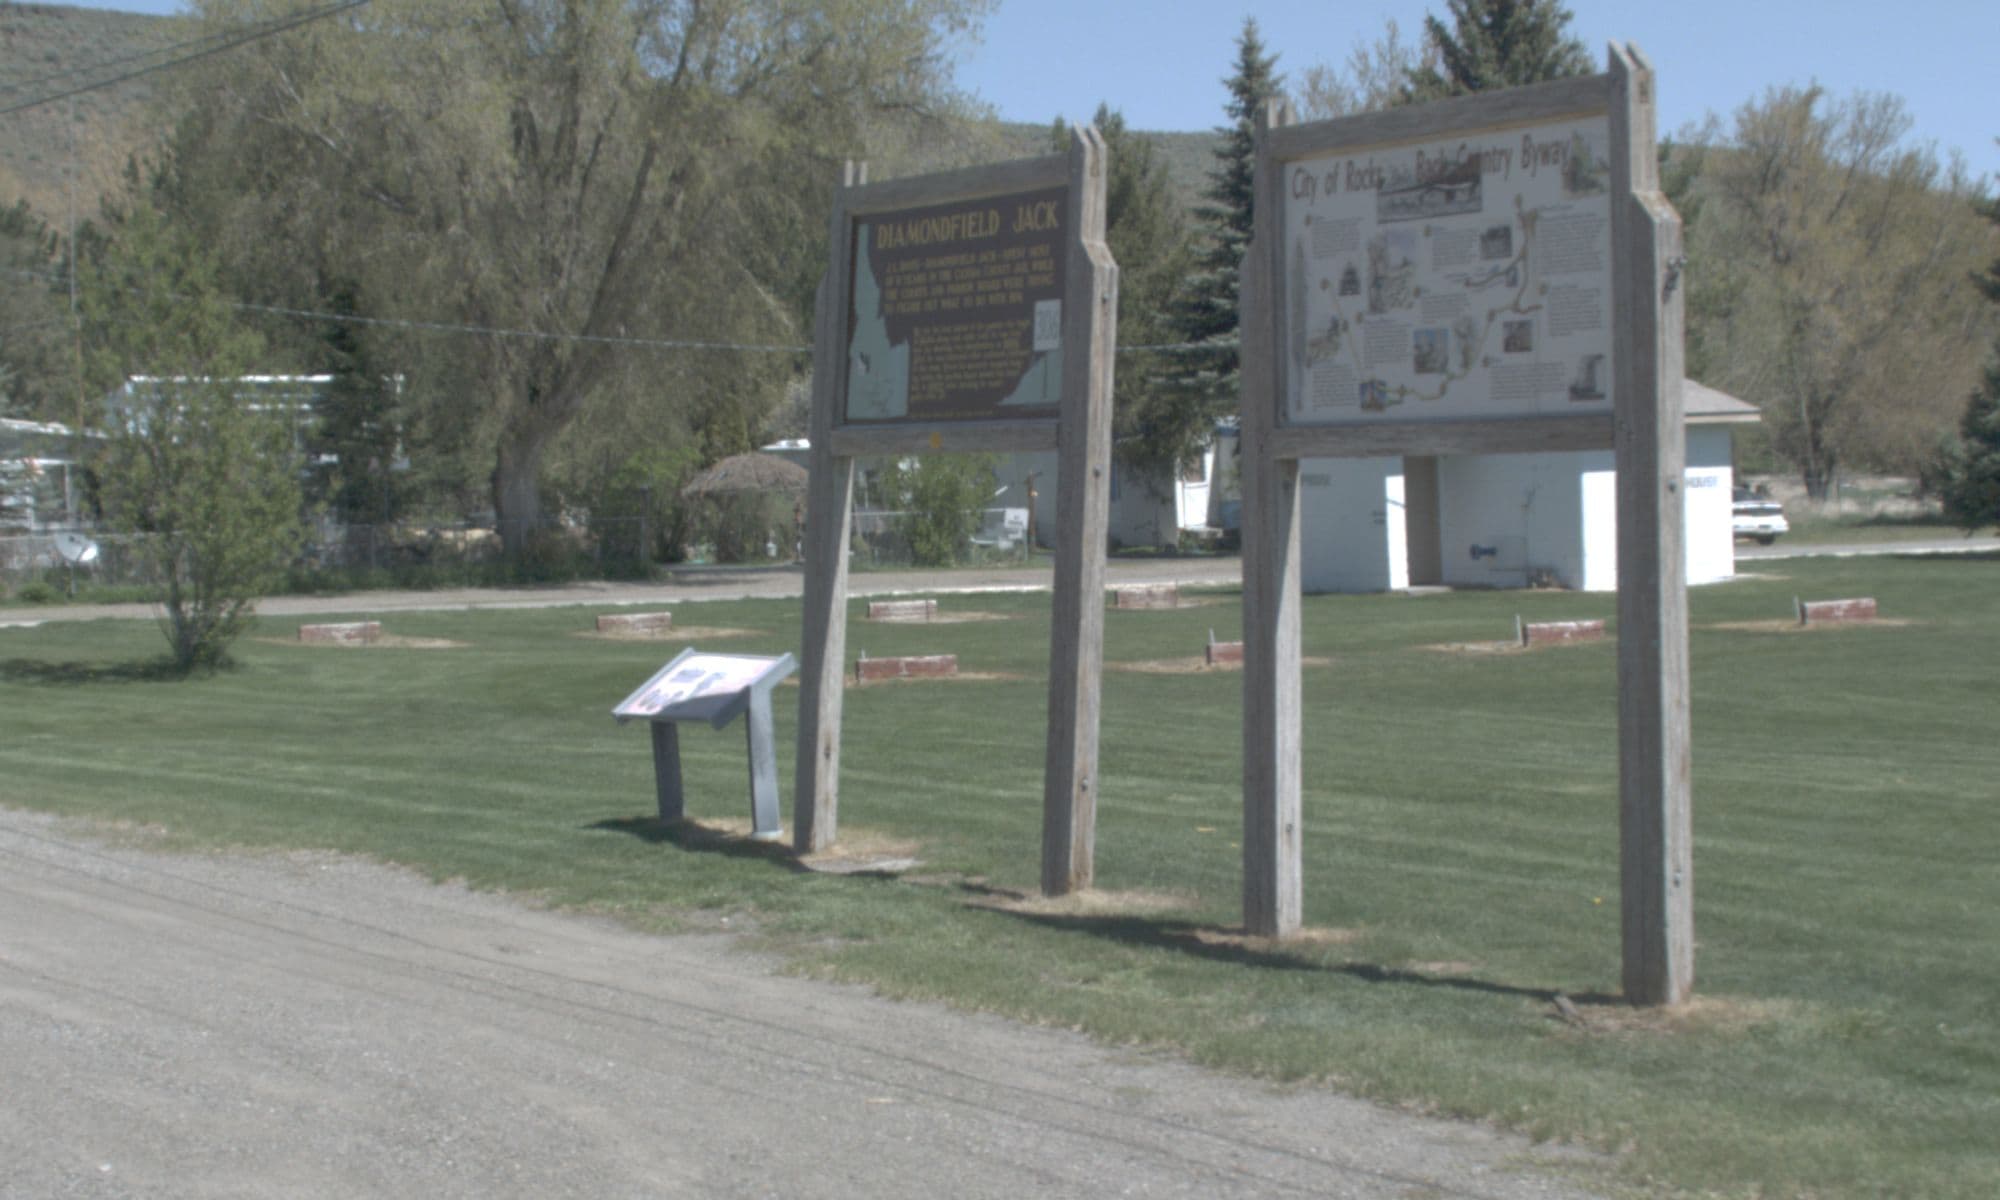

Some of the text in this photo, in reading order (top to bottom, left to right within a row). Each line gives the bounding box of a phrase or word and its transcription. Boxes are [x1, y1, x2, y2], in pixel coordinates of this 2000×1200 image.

[1293, 166, 1317, 206] City
[1325, 161, 1340, 195] of
[877, 201, 1059, 249] DIAMONDFIELD JACK
